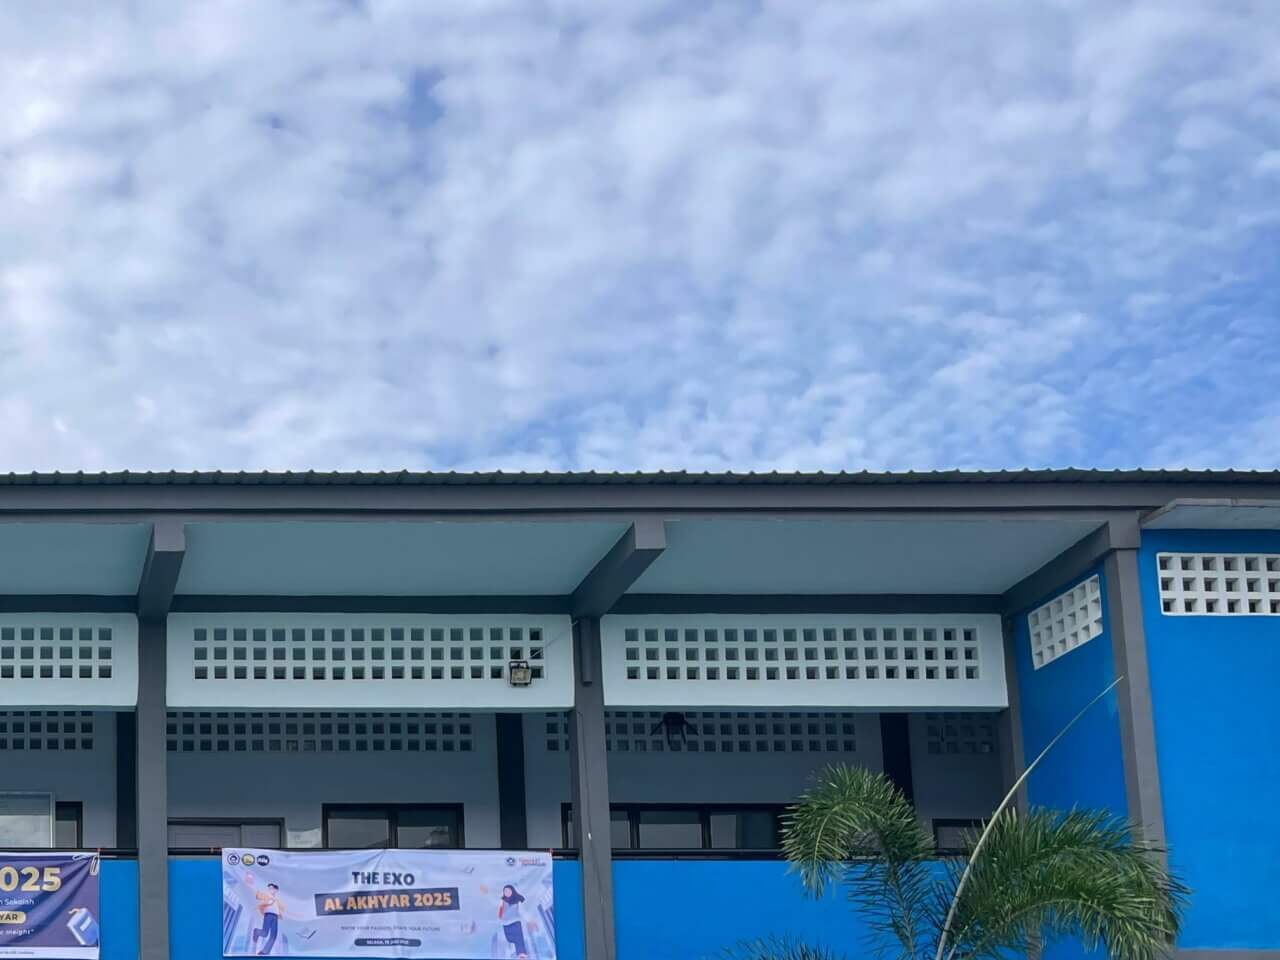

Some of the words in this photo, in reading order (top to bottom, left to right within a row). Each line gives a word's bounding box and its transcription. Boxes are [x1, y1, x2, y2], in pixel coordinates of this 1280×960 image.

[351, 872, 380, 885] THE
[382, 872, 415, 886] EXO
[323, 898, 344, 912] AL
[346, 894, 410, 911] AKHYAR
[413, 892, 452, 907] 2025
